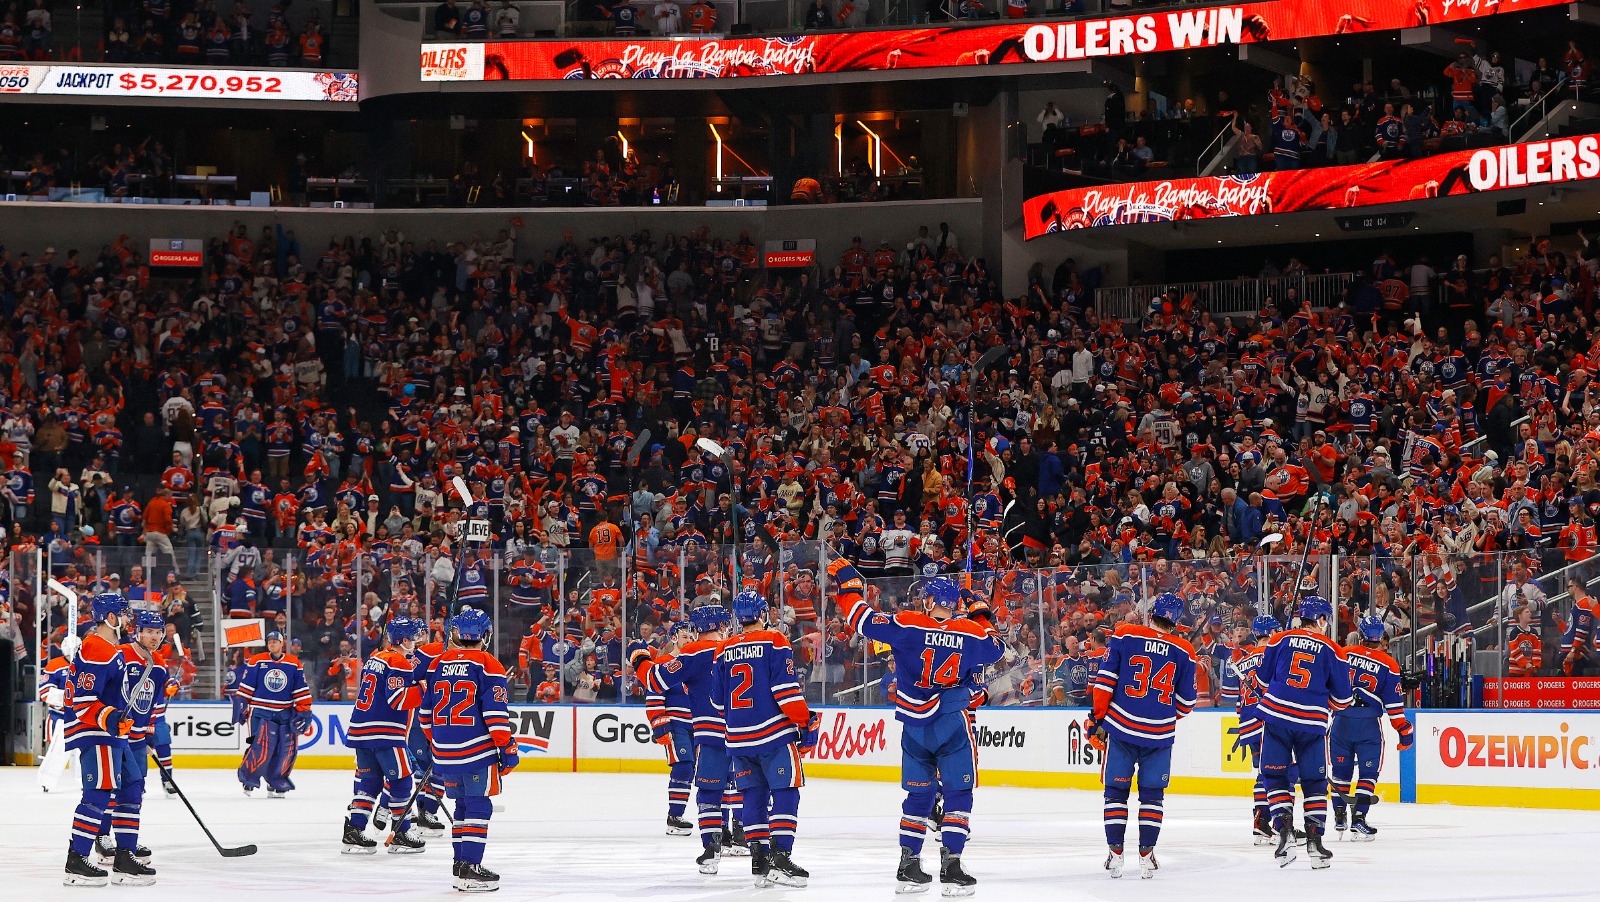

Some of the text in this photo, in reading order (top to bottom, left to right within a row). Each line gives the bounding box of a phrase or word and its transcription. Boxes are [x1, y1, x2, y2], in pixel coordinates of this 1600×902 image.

[1024, 8, 1243, 61] OILERS WIN
[421, 48, 467, 69] OILERS
[620, 45, 665, 73] Play
[699, 42, 758, 66] Bamba
[764, 40, 815, 74] baby!
[57, 73, 281, 94] JACKPOT $5,270,952
[1469, 137, 1600, 191] OILERS
[1082, 191, 1121, 220] Play
[1154, 182, 1211, 209] Bamba
[1217, 179, 1270, 214] baby!
[596, 529, 611, 544] 19
[925, 632, 964, 650] EKHOLM
[1145, 641, 1170, 656] DACH
[1288, 637, 1324, 653] MURPHY
[442, 663, 470, 677] SAVOIE
[915, 647, 962, 689] 14
[1286, 651, 1315, 689] 5
[1348, 656, 1381, 674] KAPANEN
[387, 676, 405, 690] 93
[730, 663, 754, 710] 2
[1125, 655, 1176, 706] 34
[1509, 681, 1531, 689] ROGERS
[1543, 681, 1566, 689] ROGERS
[432, 680, 478, 727] 22
